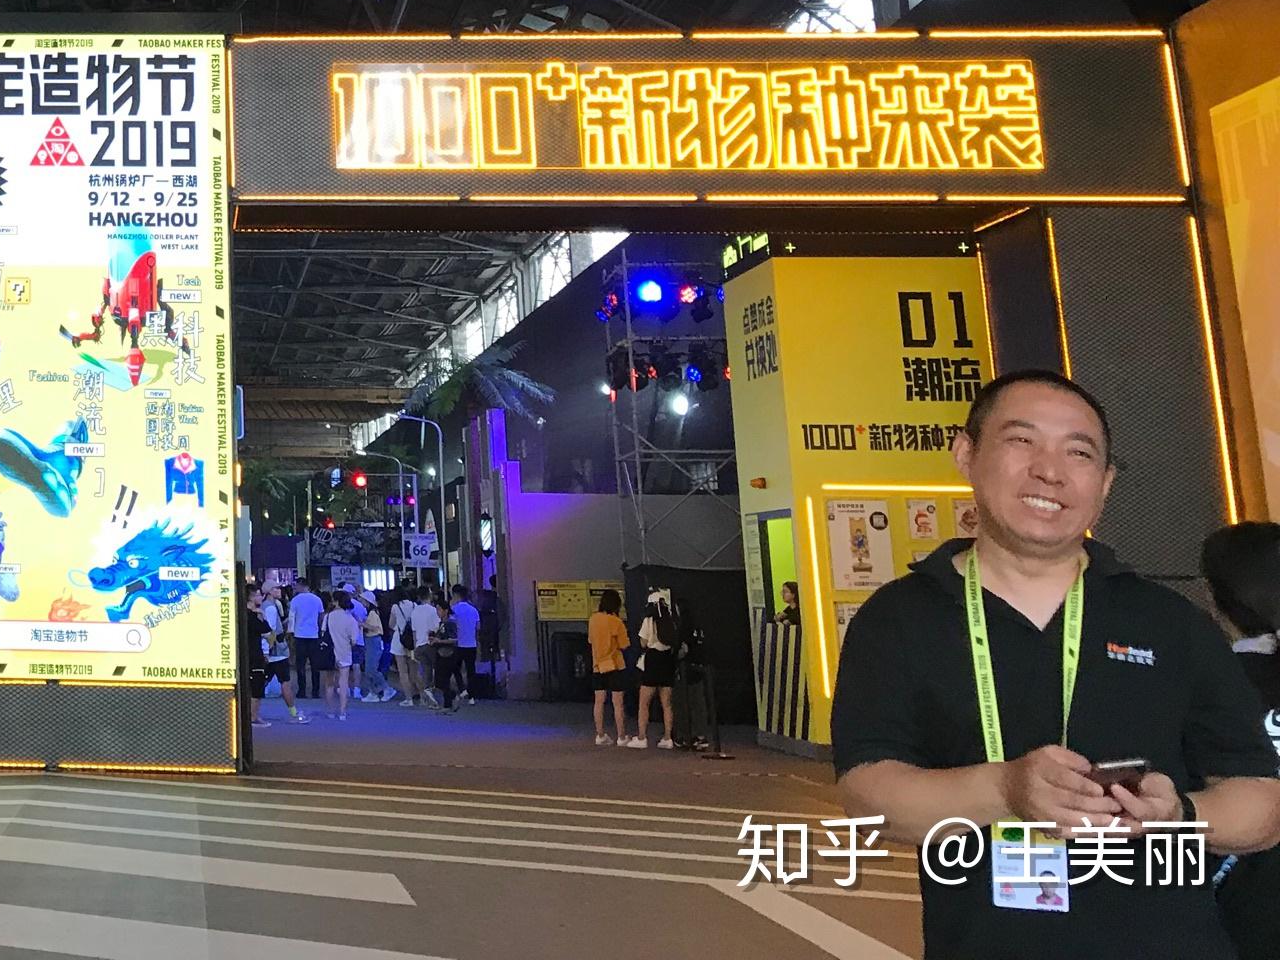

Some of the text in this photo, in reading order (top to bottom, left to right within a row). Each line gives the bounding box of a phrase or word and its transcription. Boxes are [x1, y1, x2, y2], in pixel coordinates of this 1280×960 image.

[138, 39, 171, 49] TAOBAO
[173, 39, 204, 49] MAKER
[211, 54, 221, 114] FESTIVAL 2019
[90, 121, 196, 167] 2019
[88, 191, 198, 207] 9/12 9/25
[88, 211, 198, 228] HANGZHOU
[212, 155, 224, 290] TAOBAO MAKER FESTIVAL 2019
[176, 274, 202, 287] Tech
[745, 330, 778, 381] 兑换处
[29, 370, 69, 382] Fashion
[902, 357, 981, 402] 潮流
[72, 369, 107, 435] 潮流
[215, 334, 228, 475] TAOBAO MAKER FESTIVAL 2019
[412, 545, 428, 556] 66
[220, 596, 231, 642] FESTIVAL
[30, 628, 88, 642] 淘宝造物节
[142, 667, 177, 678] TAOBAO
[180, 667, 213, 678] MAKER
[981, 672, 991, 702] FESTIVAL
[986, 703, 995, 729] MAKER
